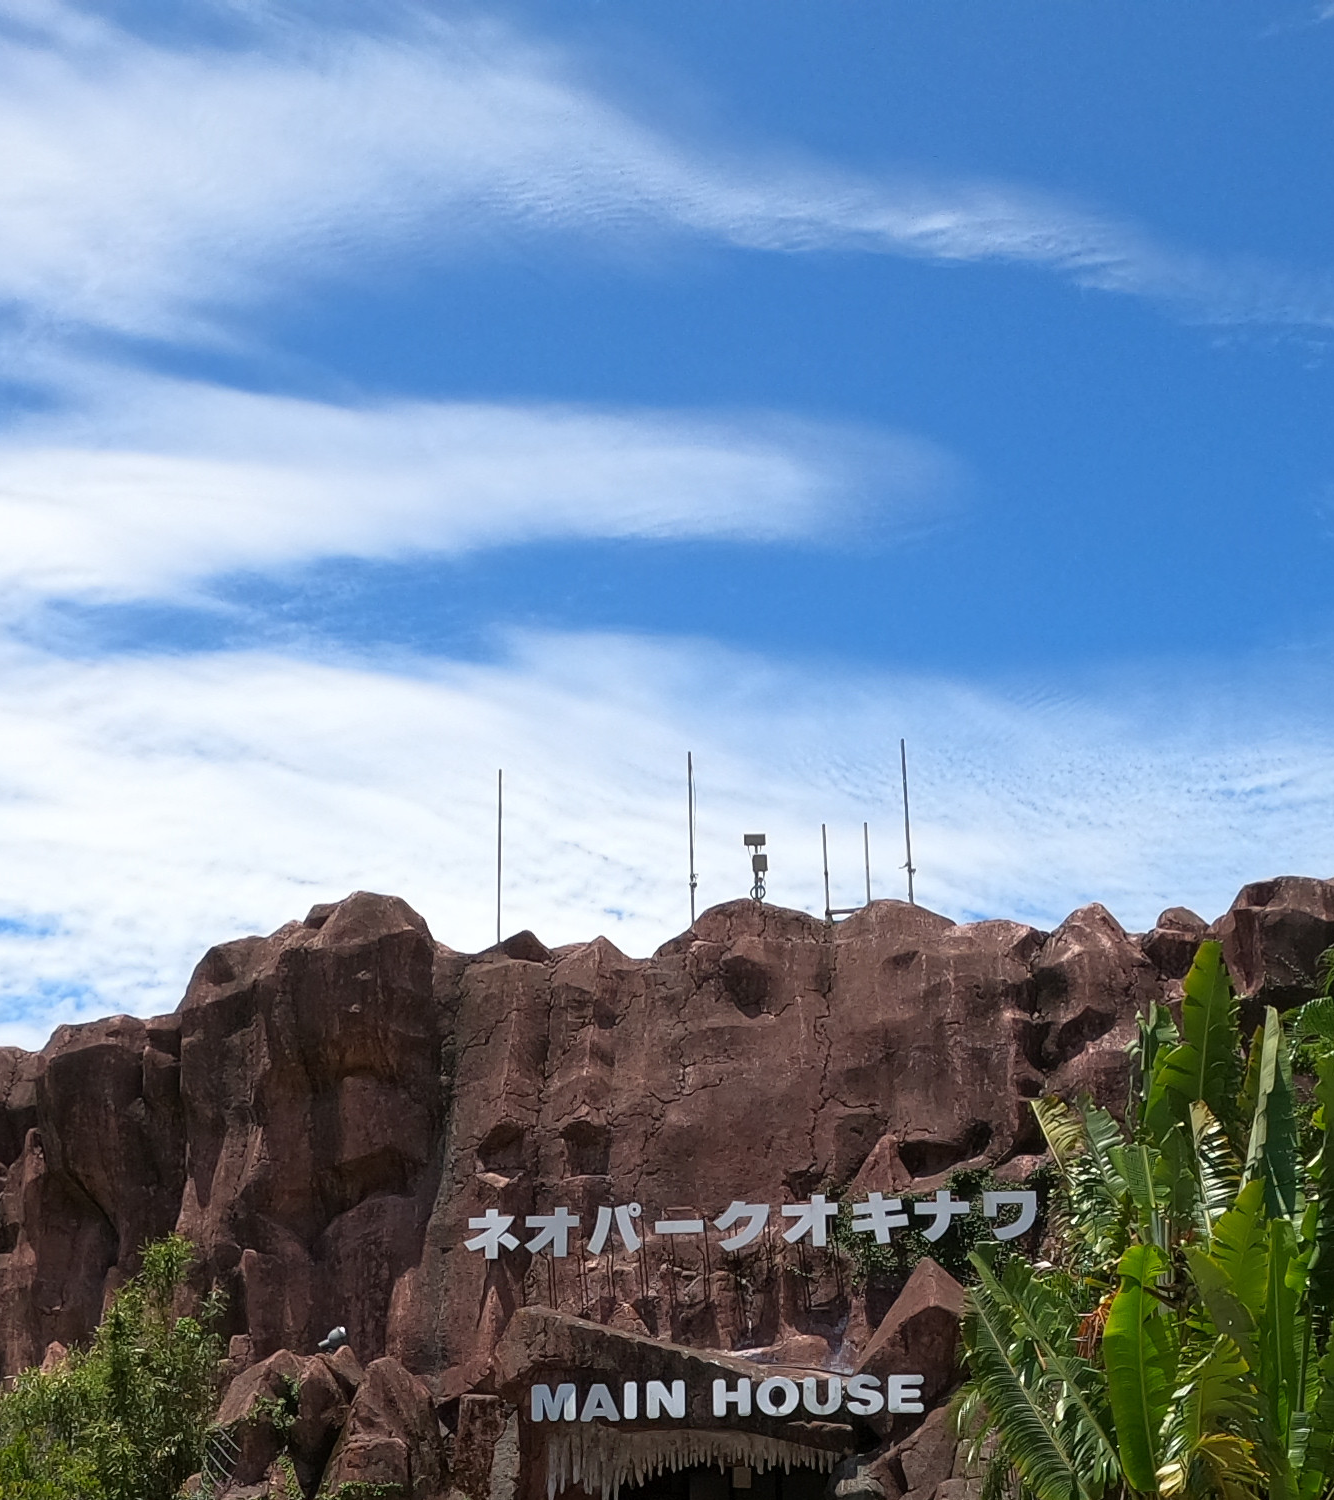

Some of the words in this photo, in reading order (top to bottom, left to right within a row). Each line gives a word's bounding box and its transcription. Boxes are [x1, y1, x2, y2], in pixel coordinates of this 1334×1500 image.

[466, 1190, 1038, 1259] ネオパークオキナワ
[530, 1380, 686, 1422] MAIN
[712, 1374, 925, 1418] HOUSE
